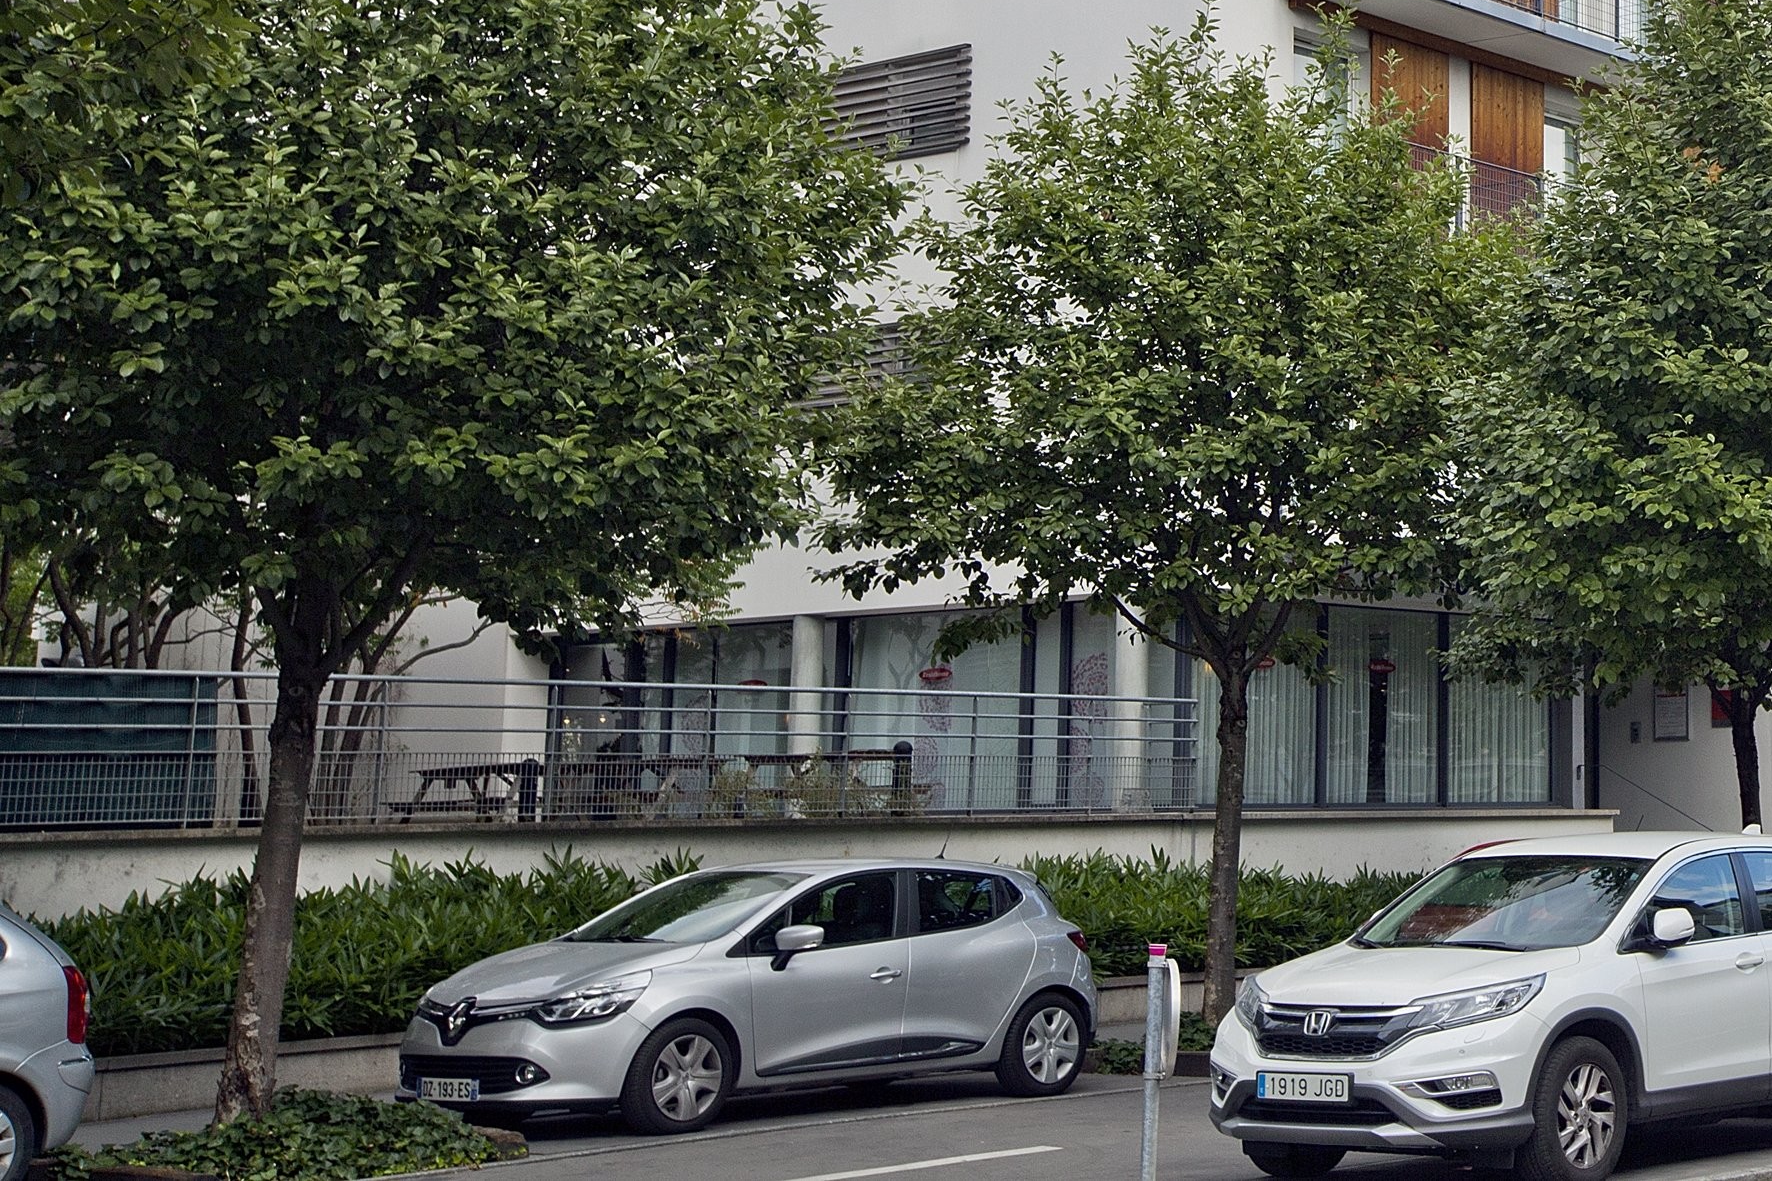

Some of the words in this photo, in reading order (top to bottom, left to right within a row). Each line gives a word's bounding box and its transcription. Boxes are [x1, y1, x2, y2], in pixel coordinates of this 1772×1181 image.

[423, 1081, 470, 1098] DZ-193-ES
[1271, 1077, 1307, 1096] 1919
[1314, 1079, 1344, 1097] JGD
